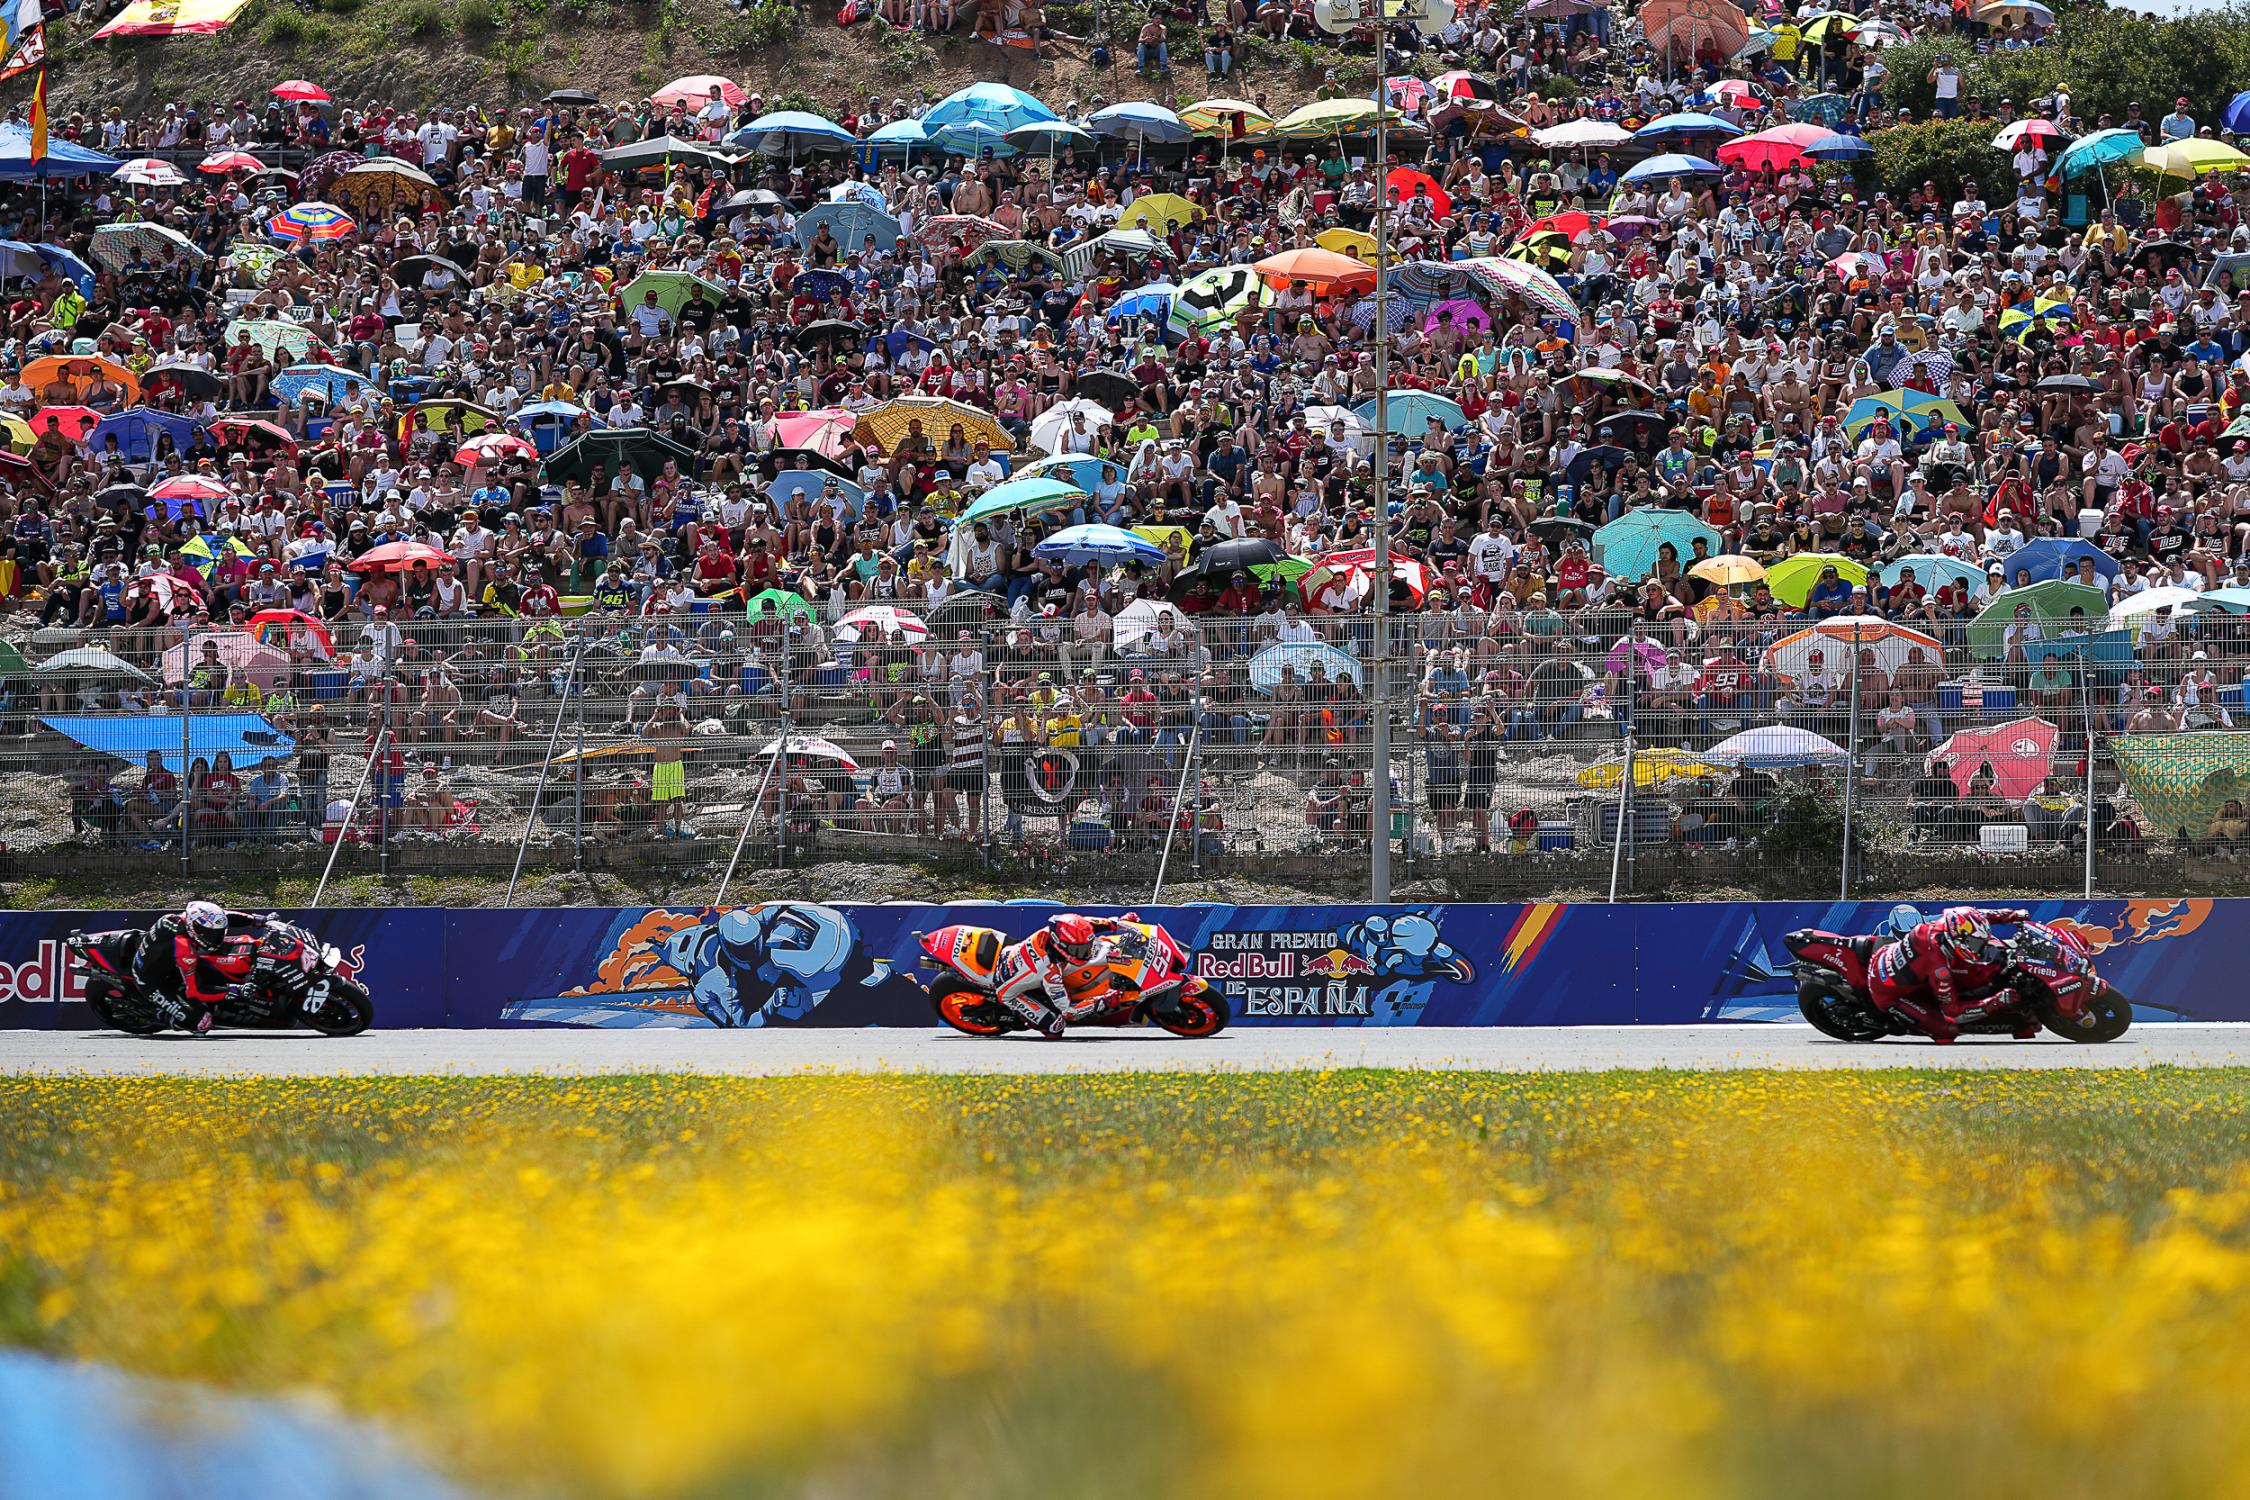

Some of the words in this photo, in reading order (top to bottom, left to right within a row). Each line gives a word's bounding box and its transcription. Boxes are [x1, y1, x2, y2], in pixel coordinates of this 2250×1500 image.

[2168, 535, 2183, 547] 93
[603, 594, 624, 605] 46
[1716, 672, 1739, 687] 93
[1212, 933, 1264, 950] GRAN
[1270, 932, 1338, 950] PREMIO
[1152, 938, 1172, 979] 93
[1198, 952, 1247, 979] Red
[1247, 952, 1295, 979] Bull
[1823, 953, 1845, 970] riello
[2034, 965, 2057, 978] riello
[1226, 980, 1247, 995] DE
[2057, 981, 2082, 995] Lenovo
[150, 988, 187, 1022] aprilia
[1246, 979, 1370, 1016] ESPAÑA
